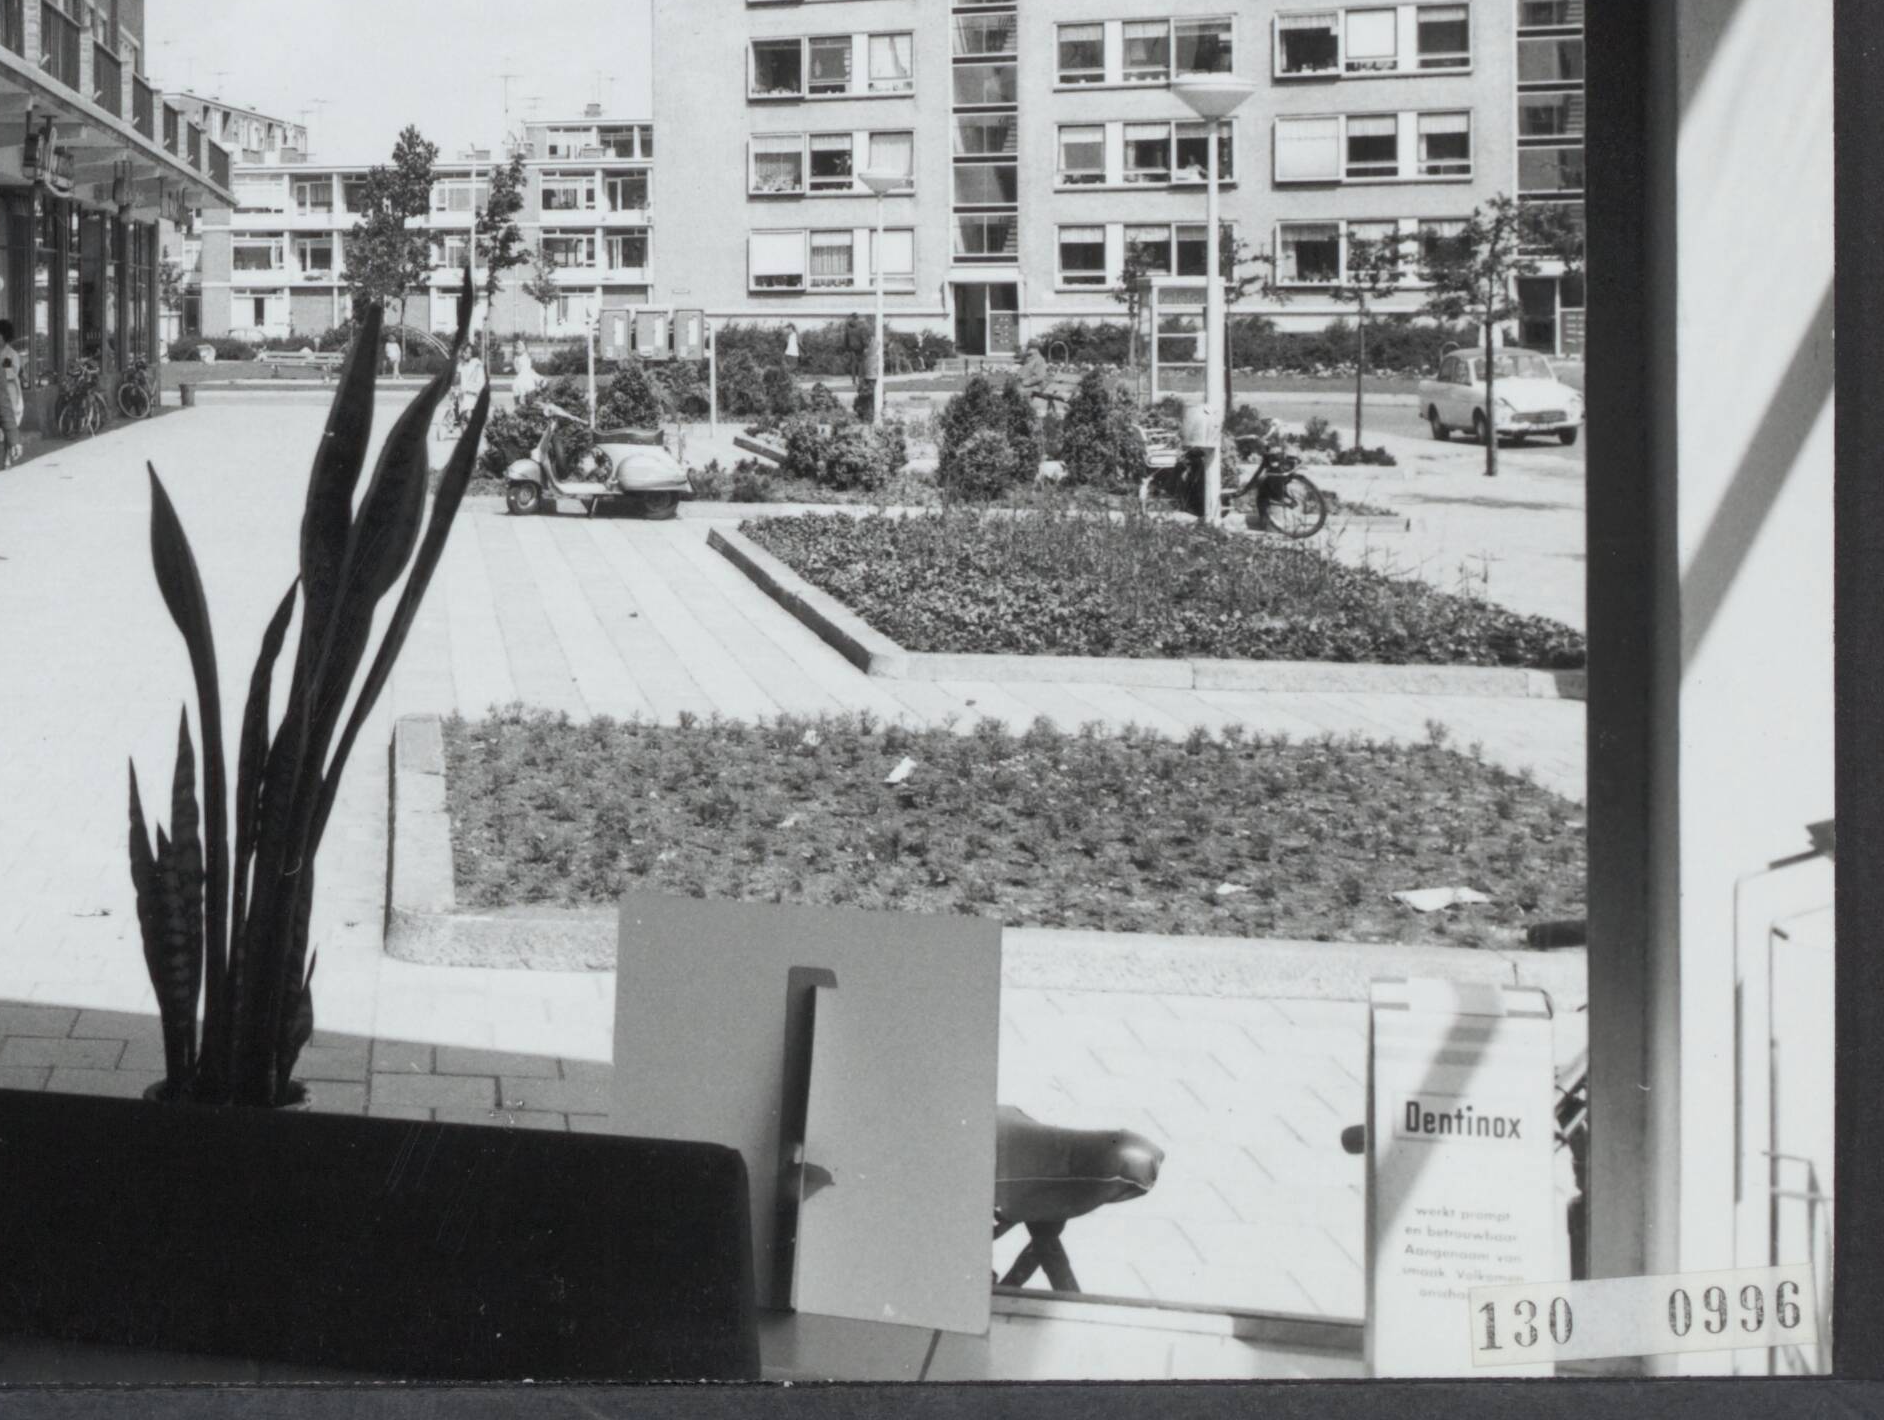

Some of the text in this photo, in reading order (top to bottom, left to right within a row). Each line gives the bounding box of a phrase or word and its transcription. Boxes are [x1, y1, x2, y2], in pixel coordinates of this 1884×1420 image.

[1405, 1100, 1522, 1140] Dentinox
[1415, 1206, 1511, 1223] werkt prompt
[1404, 1225, 1518, 1242] en betrouwbaar
[1404, 1243, 1490, 1260] Aangenaam
